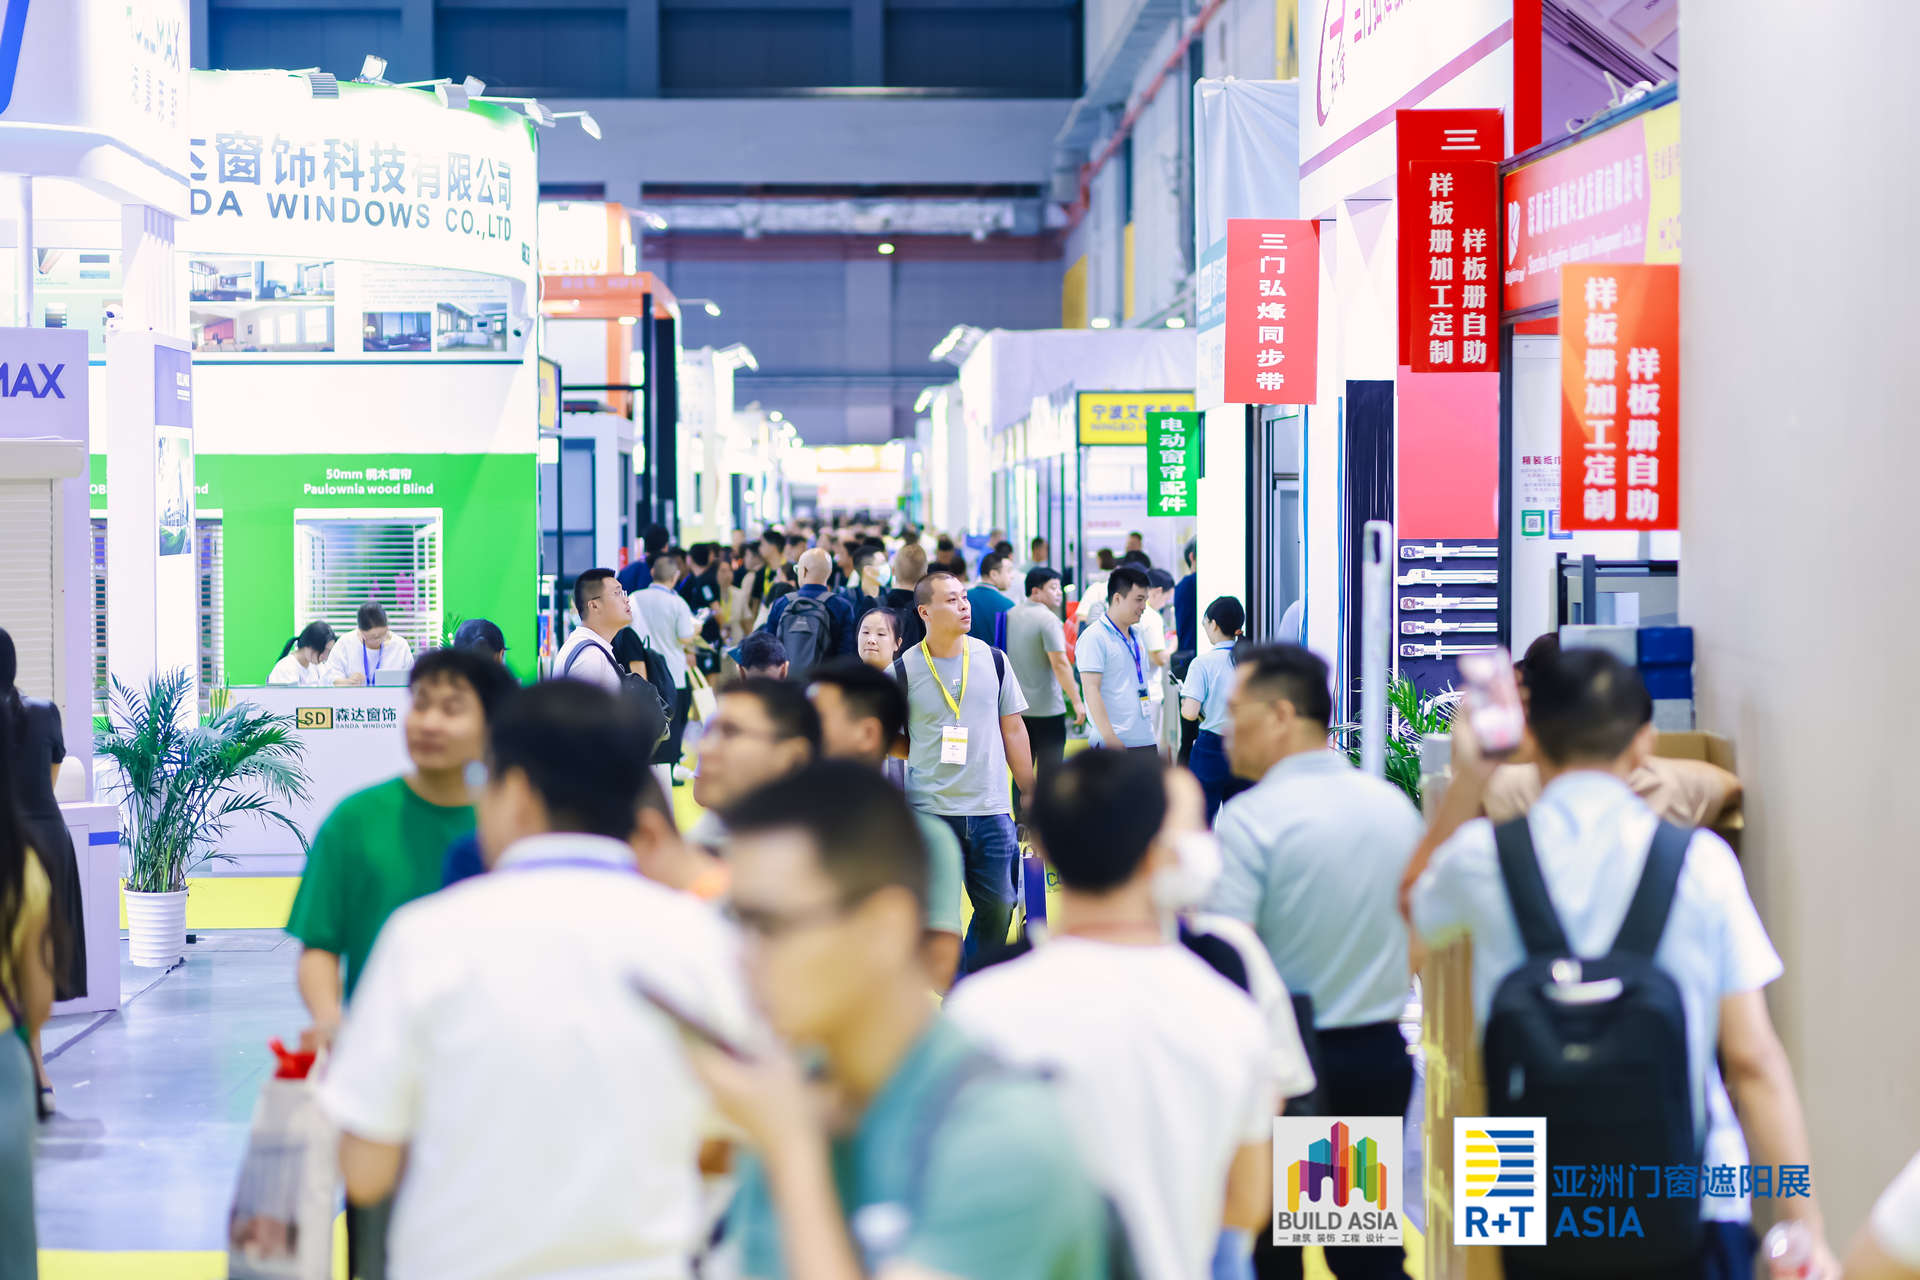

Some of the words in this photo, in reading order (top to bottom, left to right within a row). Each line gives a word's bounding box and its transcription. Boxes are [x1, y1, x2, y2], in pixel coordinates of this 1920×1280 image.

[266, 192, 431, 229] WINDOWS
[1255, 233, 1288, 391] 三门弘烽同步带
[1428, 172, 1455, 365] 样板册加工定制
[1461, 228, 1488, 365] 样板册自助
[1583, 276, 1619, 522] 样板册加工定制
[1626, 347, 1661, 522] 样板册自助
[303, 483, 365, 495] Paulownia
[367, 483, 401, 495] wood
[403, 483, 434, 495] Blind
[326, 468, 363, 480] 50mm
[1159, 417, 1188, 512] 电动窗帘配件
[304, 712, 326, 725] SD
[335, 708, 397, 722] 森达窗饰
